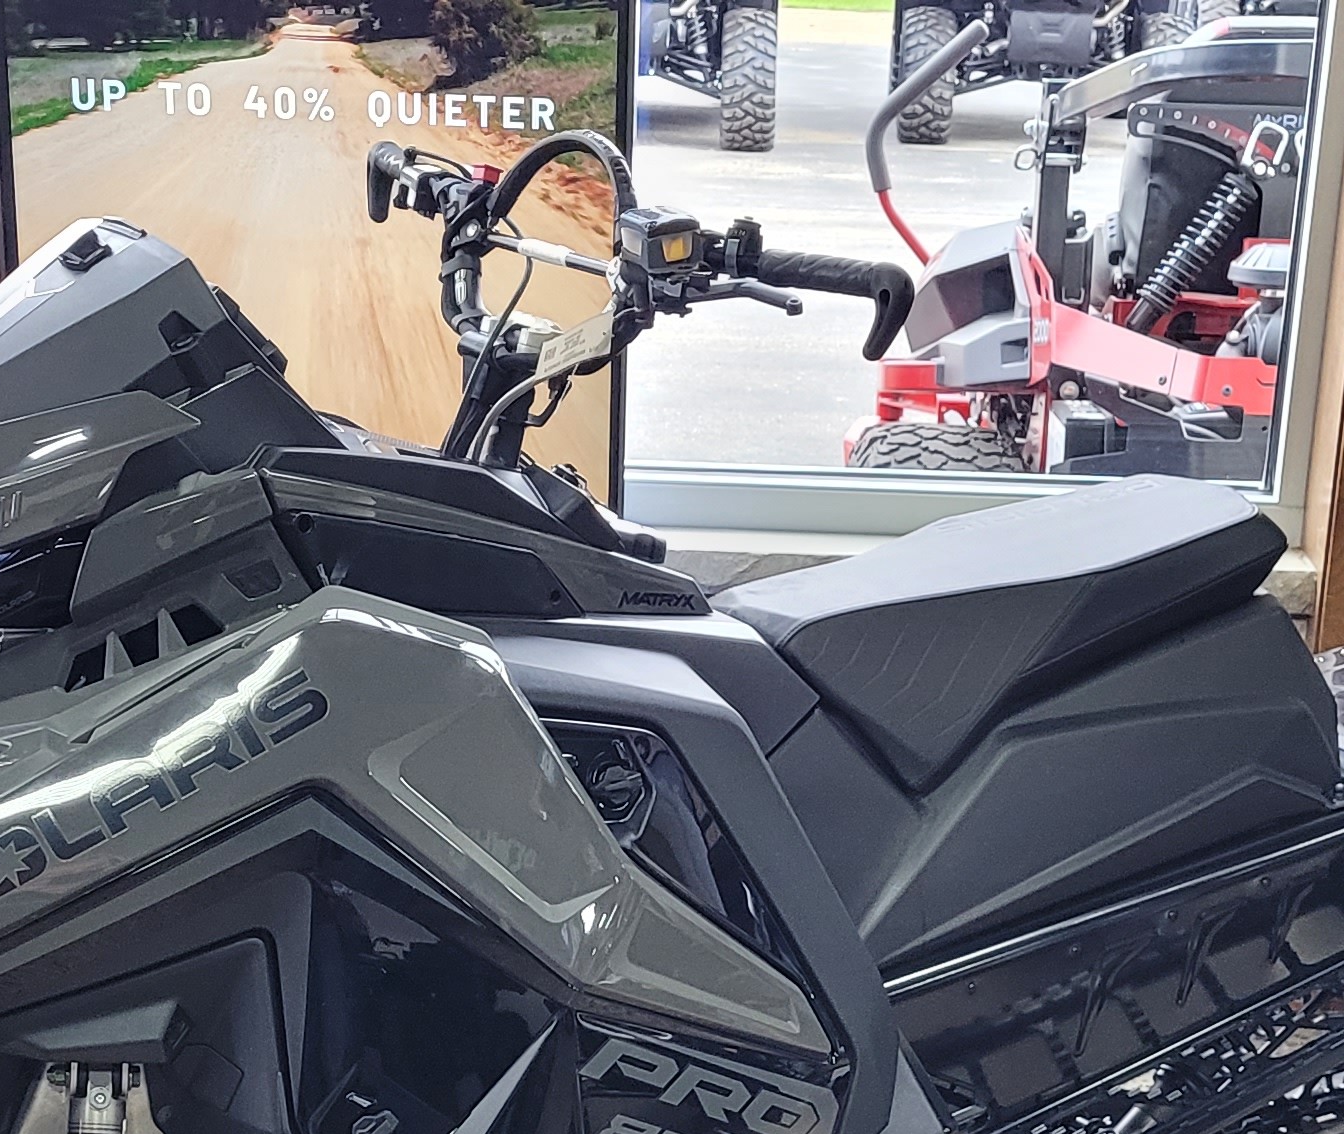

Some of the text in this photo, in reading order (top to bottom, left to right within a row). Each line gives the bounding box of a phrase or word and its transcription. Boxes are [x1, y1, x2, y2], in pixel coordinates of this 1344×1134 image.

[71, 77, 555, 131] UP TO 40% QUIETER
[618, 590, 696, 611] MATRYX
